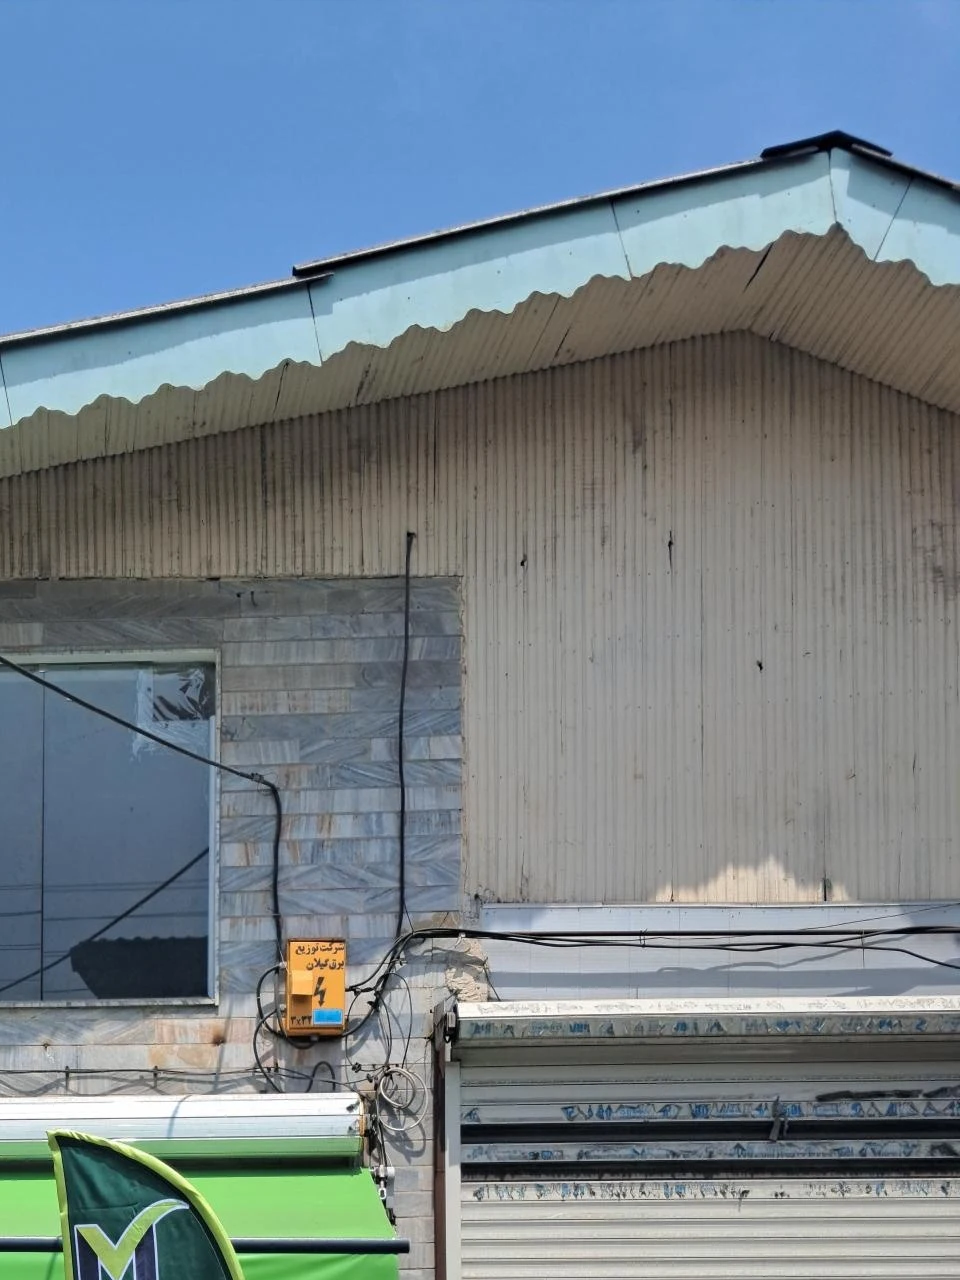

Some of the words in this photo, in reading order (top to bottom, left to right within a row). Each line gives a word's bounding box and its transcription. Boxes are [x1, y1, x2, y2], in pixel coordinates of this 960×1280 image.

[295, 943, 319, 955] توزیع
[306, 957, 329, 970] گیلان
[328, 959, 345, 970] برق
